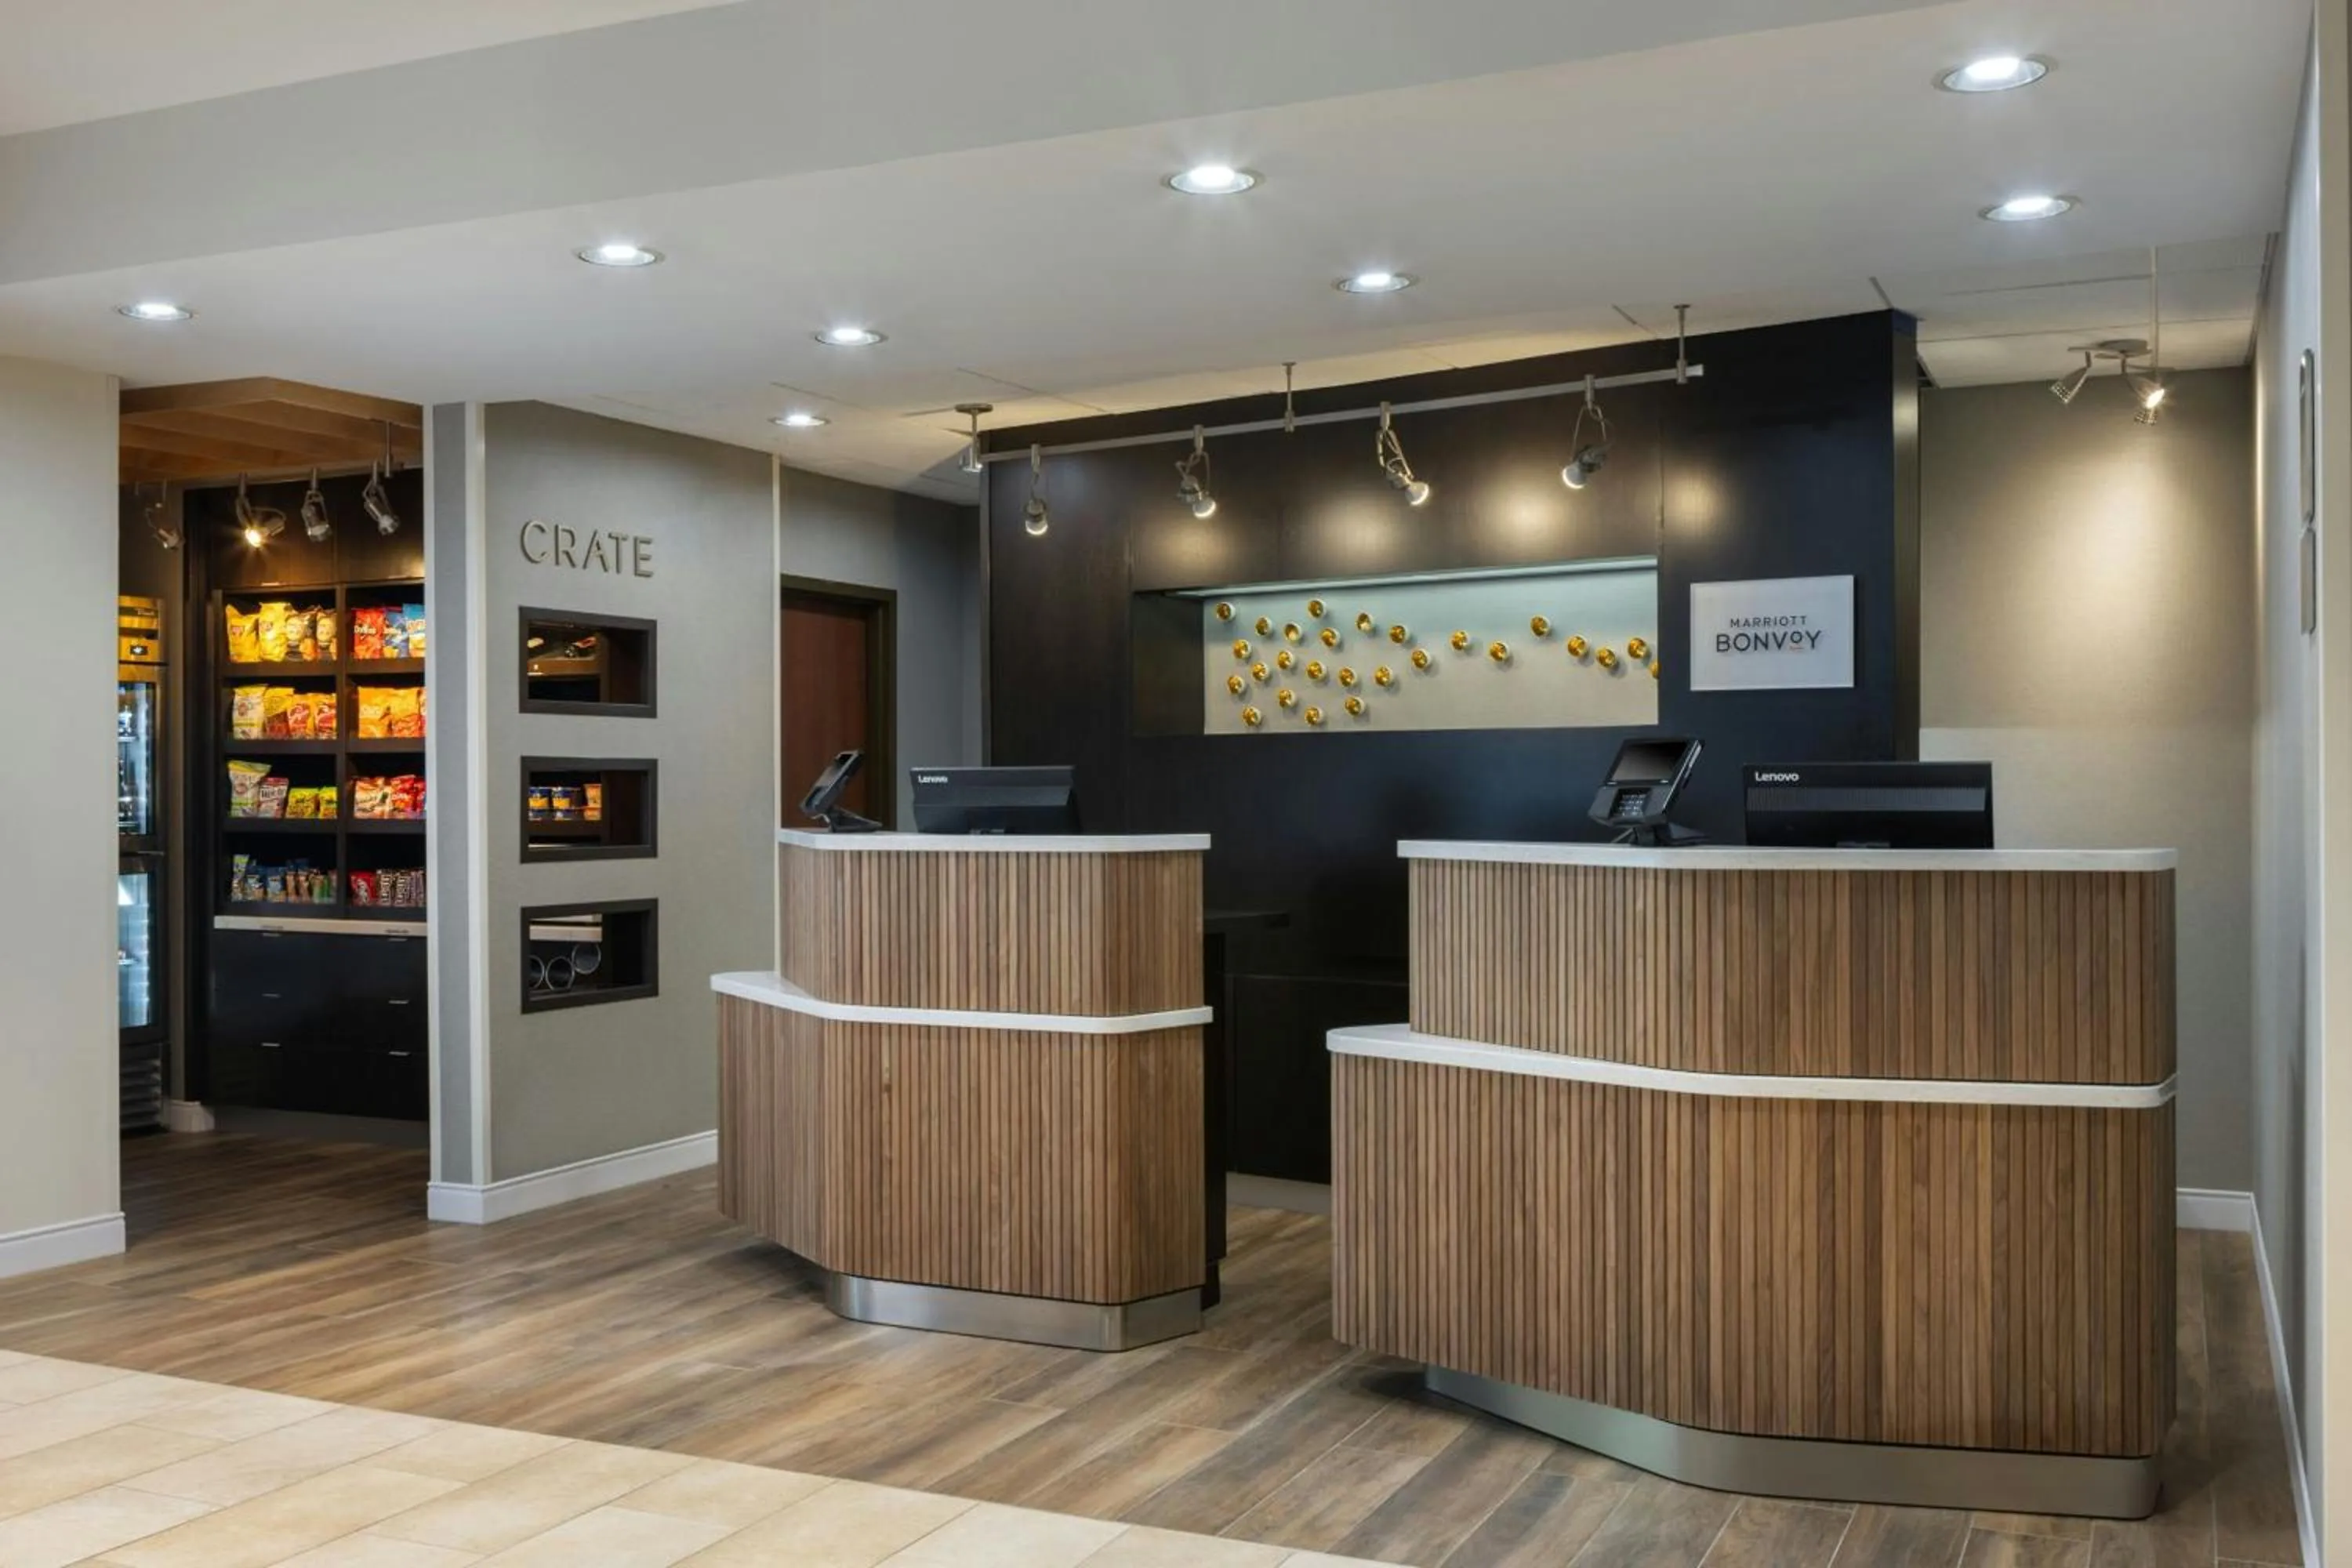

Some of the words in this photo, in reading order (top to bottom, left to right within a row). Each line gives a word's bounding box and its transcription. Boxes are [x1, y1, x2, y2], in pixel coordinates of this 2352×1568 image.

[519, 520, 655, 579] CRATE
[1730, 615, 1807, 628] MARRIOTT
[1715, 630, 1822, 653] BONVOY
[917, 775, 949, 783] Lenovo
[1754, 771, 1800, 782] Lenovo
